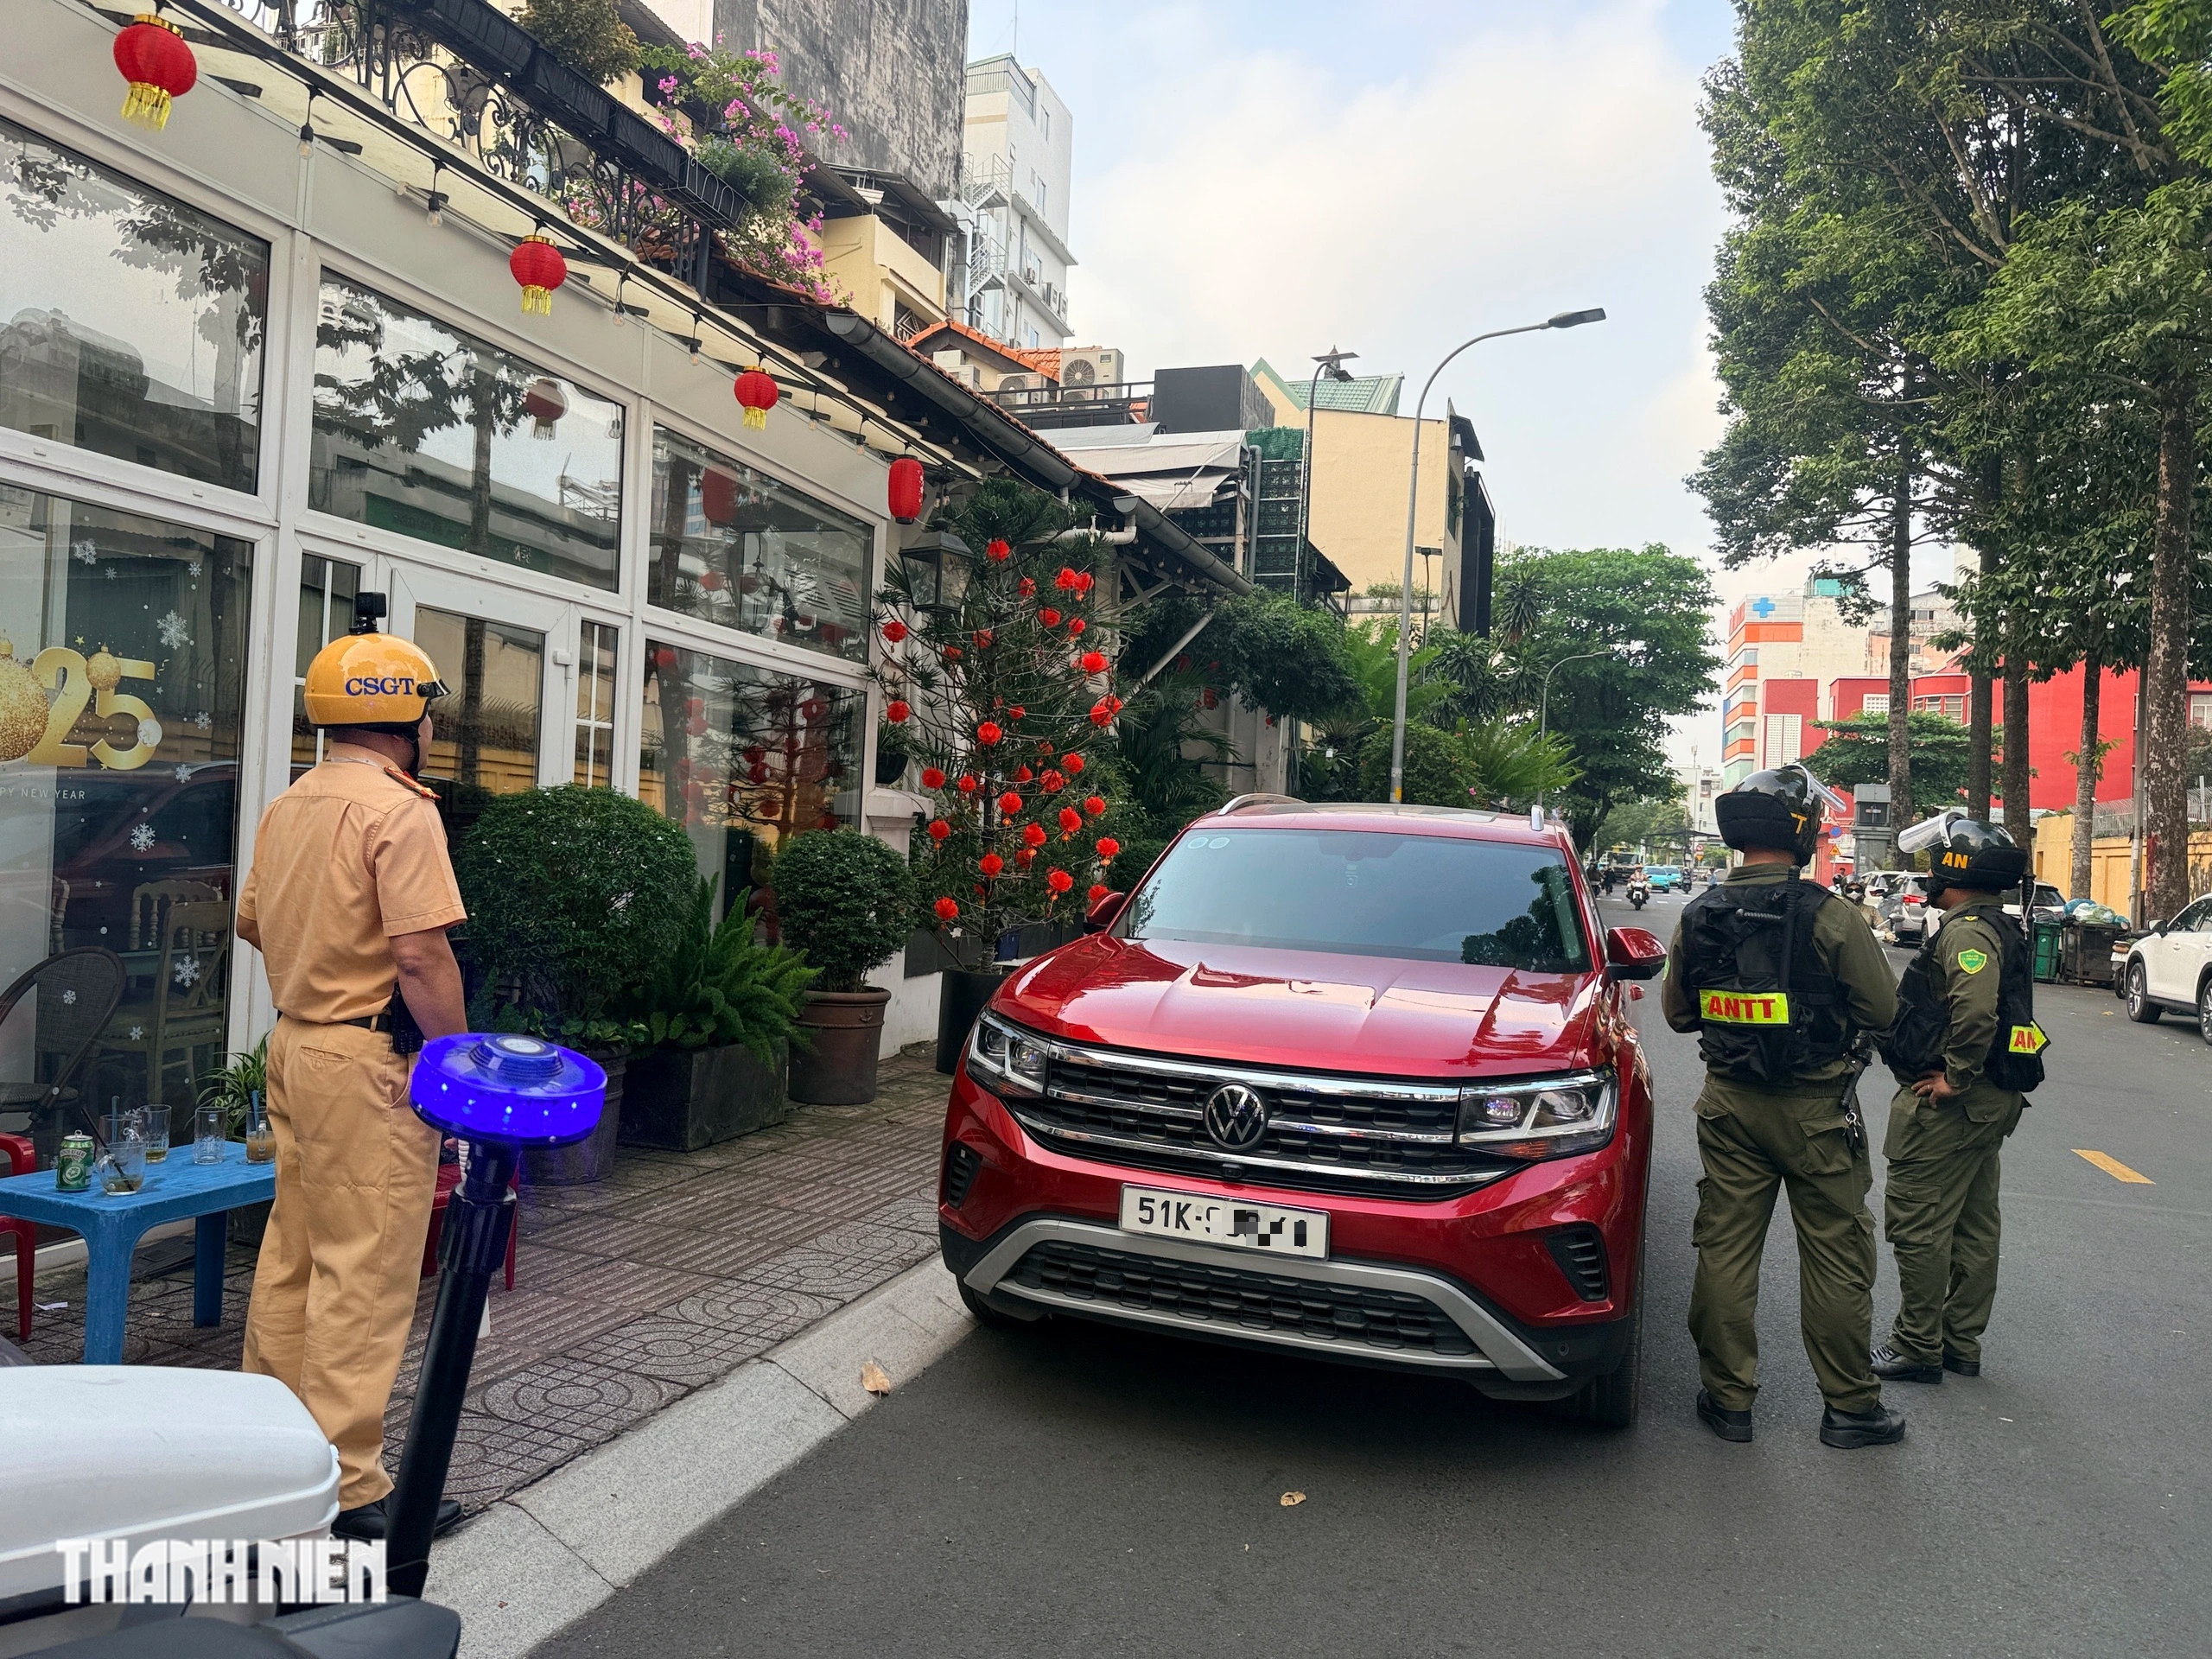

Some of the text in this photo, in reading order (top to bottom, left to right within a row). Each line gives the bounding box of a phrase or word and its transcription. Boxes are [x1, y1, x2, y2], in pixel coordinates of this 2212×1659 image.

[346, 677, 415, 696] CSGT
[21, 787, 49, 798] NEW
[54, 789, 86, 800] YEAR
[1708, 995, 1776, 1020] ANTT
